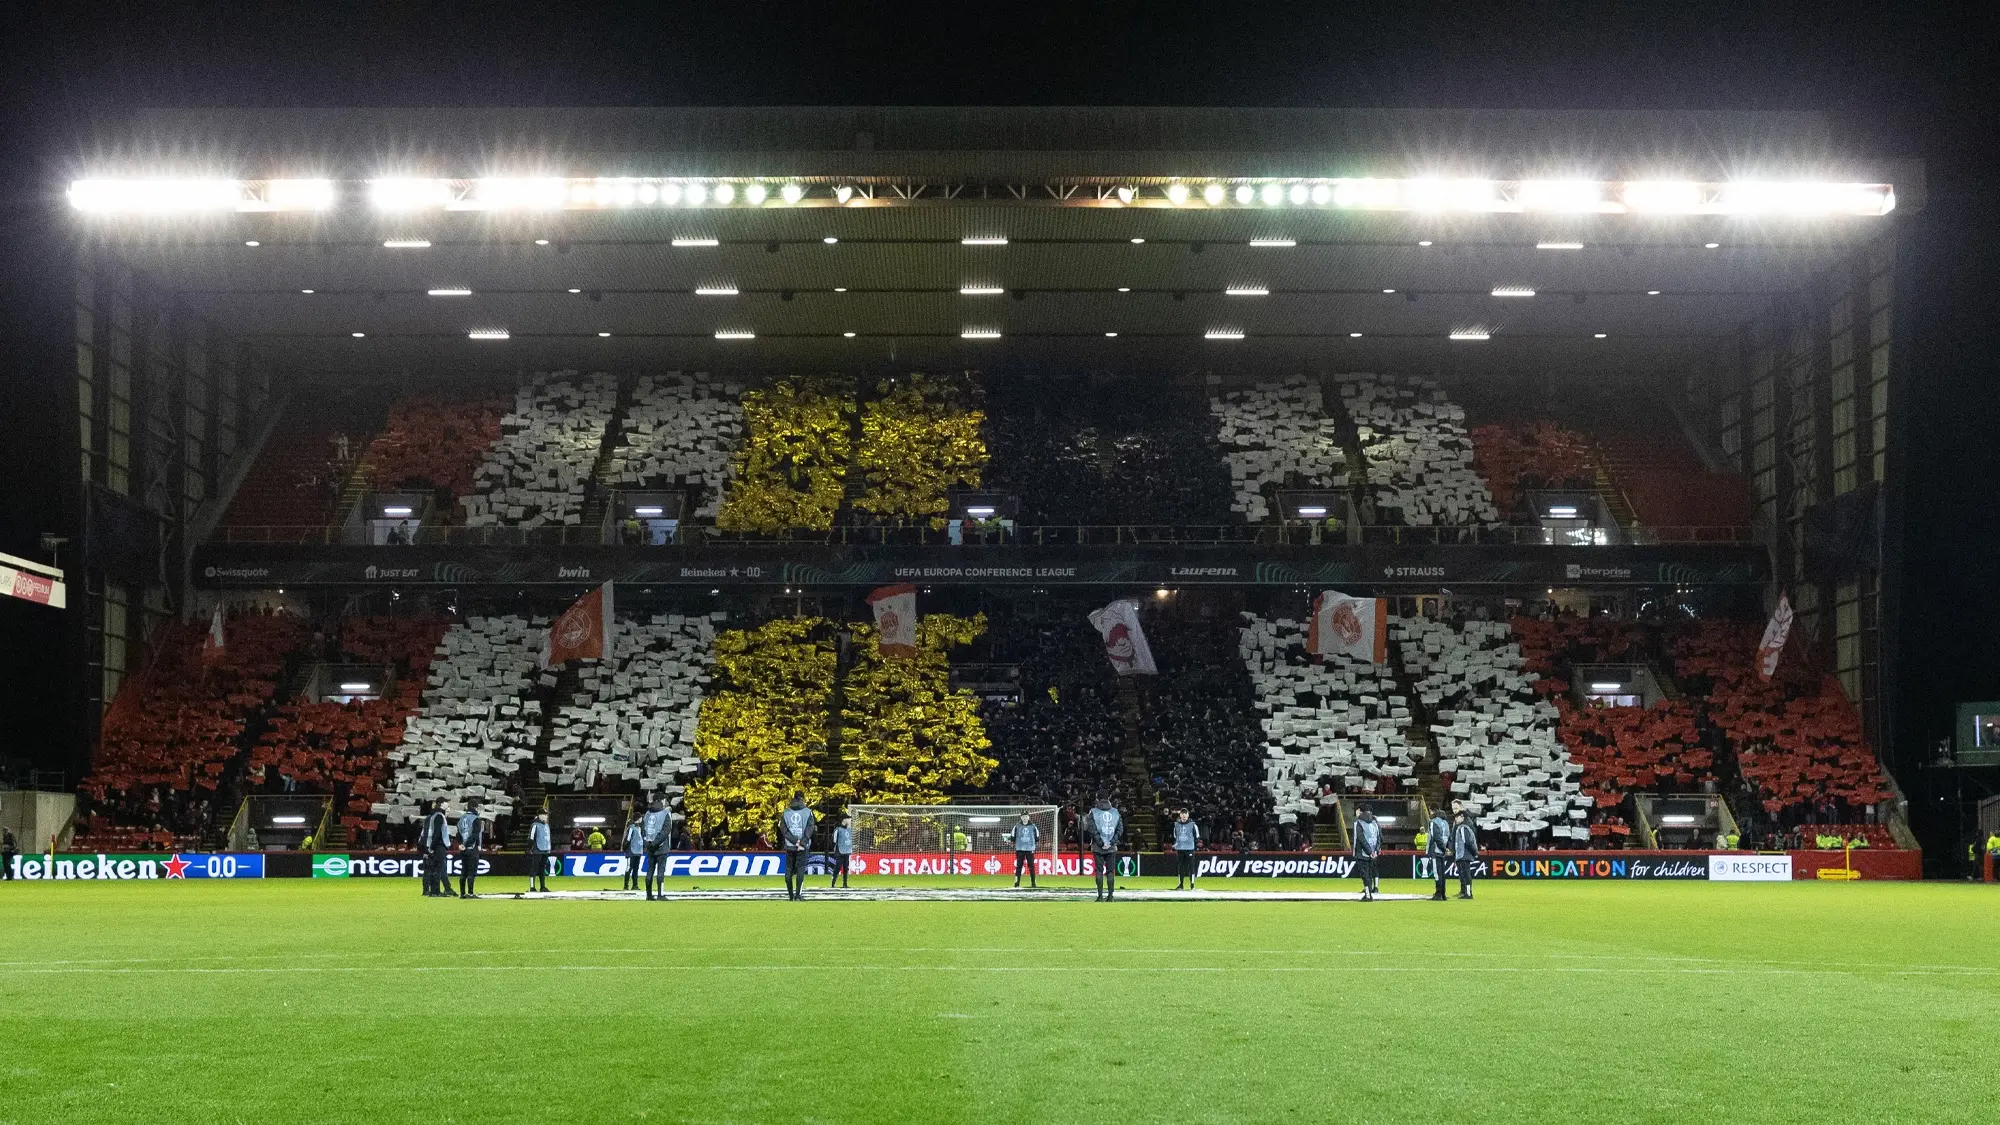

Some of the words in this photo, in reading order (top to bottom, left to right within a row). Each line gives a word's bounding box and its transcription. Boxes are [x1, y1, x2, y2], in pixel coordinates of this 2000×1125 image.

[216, 567, 269, 577] Swissquote
[380, 569, 400, 577] JUST
[402, 569, 418, 577] EAT
[558, 566, 590, 577] bwin
[680, 567, 726, 577] Heineken
[895, 568, 921, 576] UEFA
[924, 568, 963, 576] EUROPA
[965, 568, 1033, 576] CONFERENCE
[1036, 568, 1075, 576] LEAGUE
[1396, 567, 1445, 576] STRAUSS
[878, 858, 971, 875] STRAUSS
[1197, 856, 1240, 878] play
[1244, 856, 1356, 878] responsibly
[1492, 860, 1626, 877] FOUNDATION
[1630, 860, 1650, 878] for
[1653, 859, 1705, 877] children
[1733, 862, 1789, 874] RESPECT
